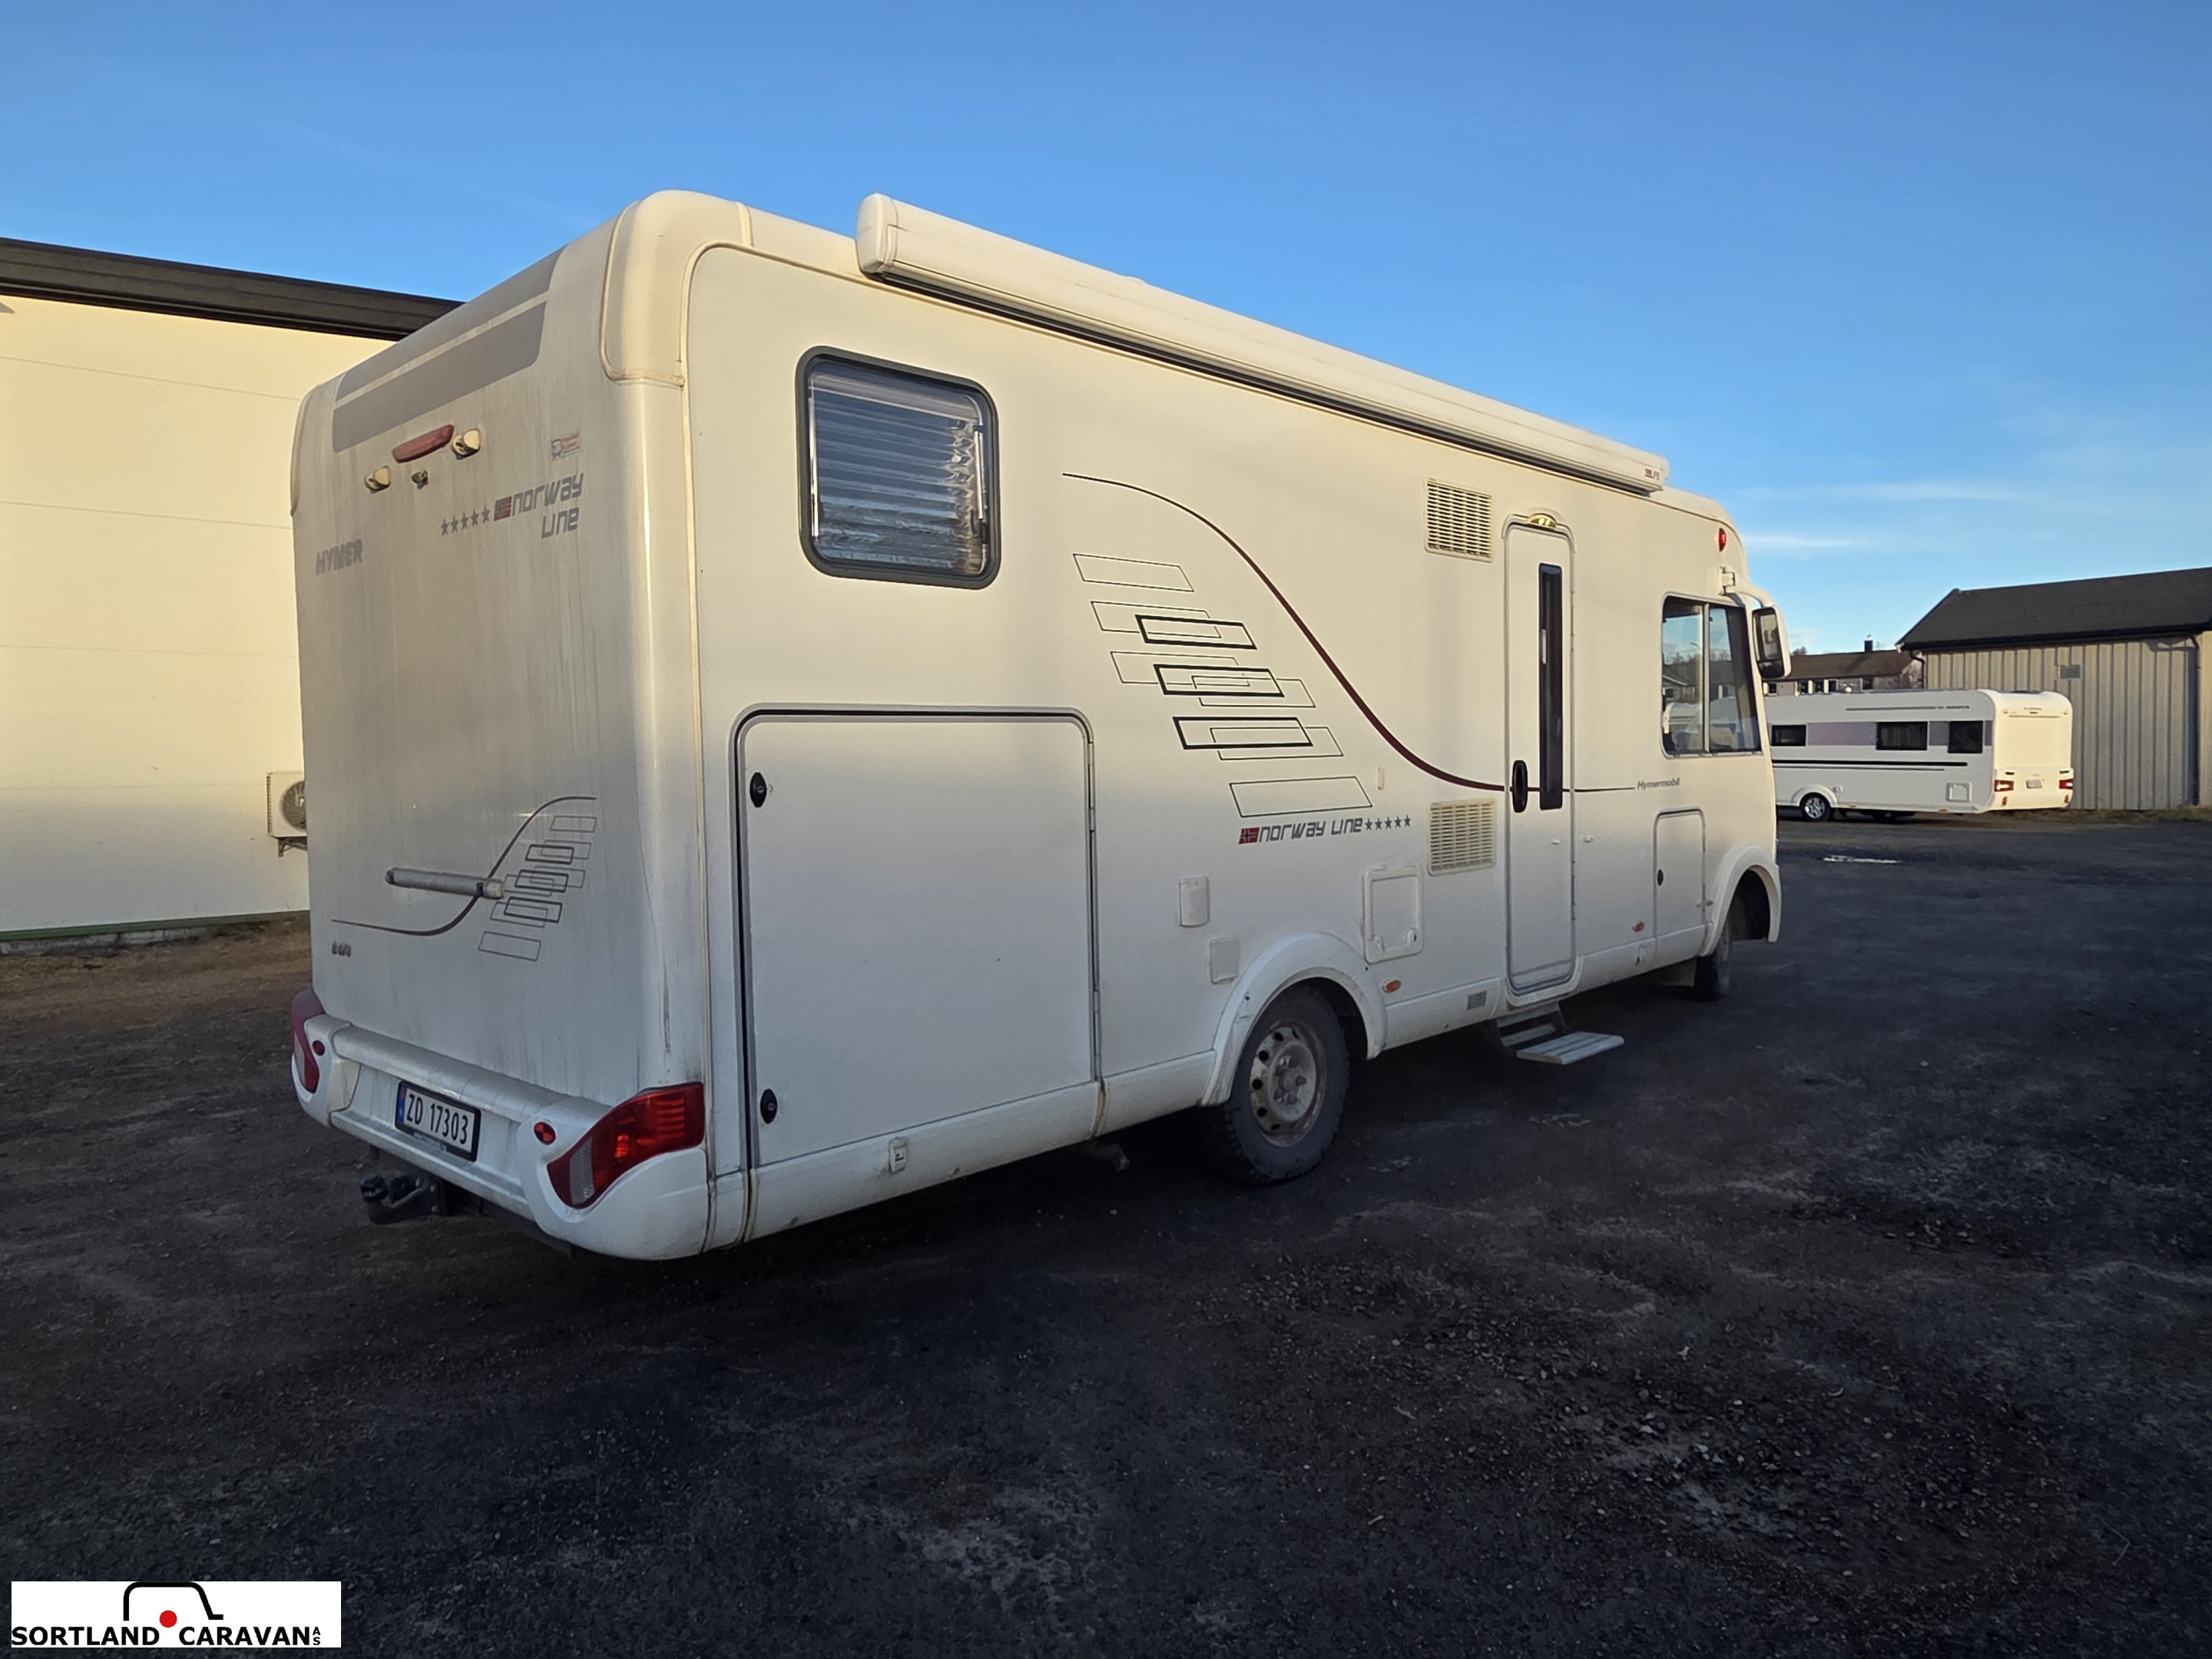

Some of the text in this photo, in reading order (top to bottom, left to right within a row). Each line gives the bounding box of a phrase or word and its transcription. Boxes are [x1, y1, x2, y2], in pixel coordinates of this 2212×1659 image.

[316, 538, 363, 576] HYMER
[406, 1093, 469, 1144] ZD 17303
